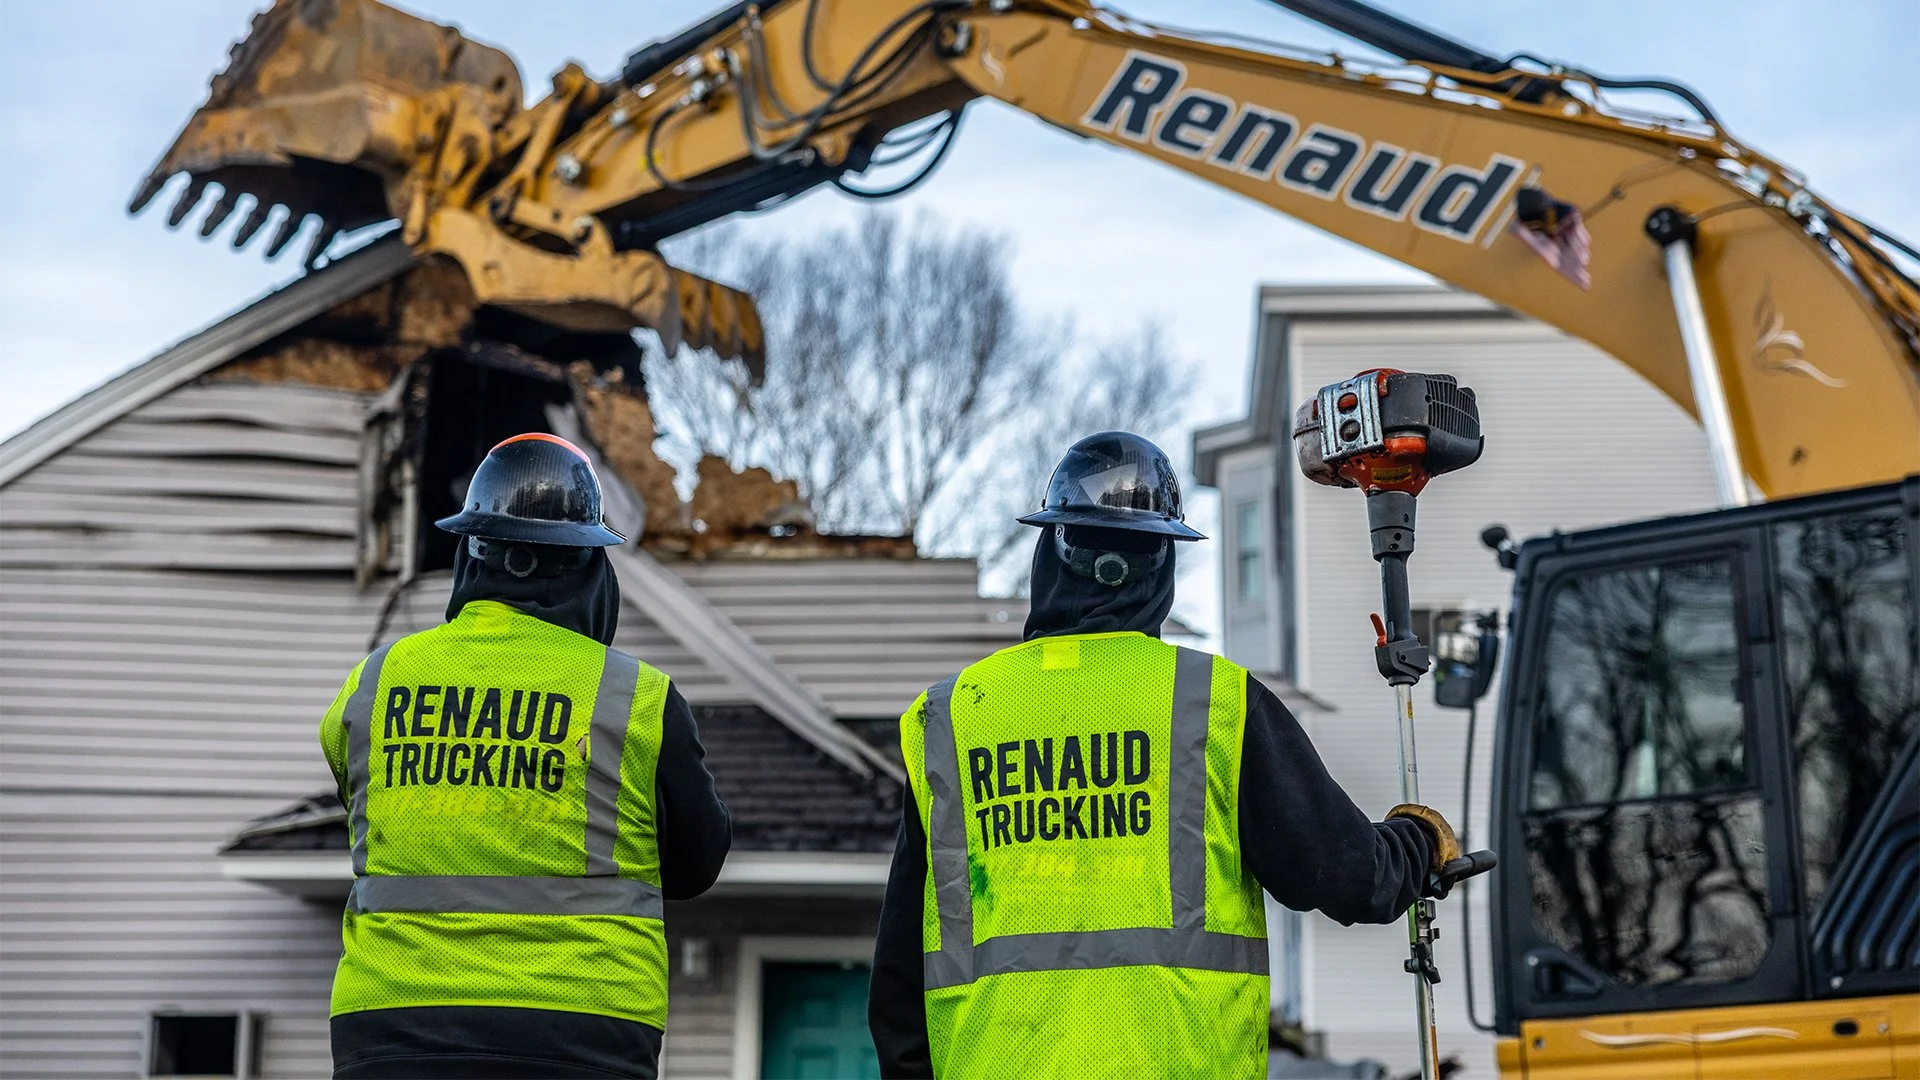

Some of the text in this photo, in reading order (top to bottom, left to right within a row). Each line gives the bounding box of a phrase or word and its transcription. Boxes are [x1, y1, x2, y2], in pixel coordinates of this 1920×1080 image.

[1083, 51, 1523, 240] Renaud
[384, 685, 572, 744] RENAUD
[383, 743, 565, 792] TRUCKING
[968, 730, 1150, 803] RENAUD
[976, 791, 1150, 851] TRUCKING
